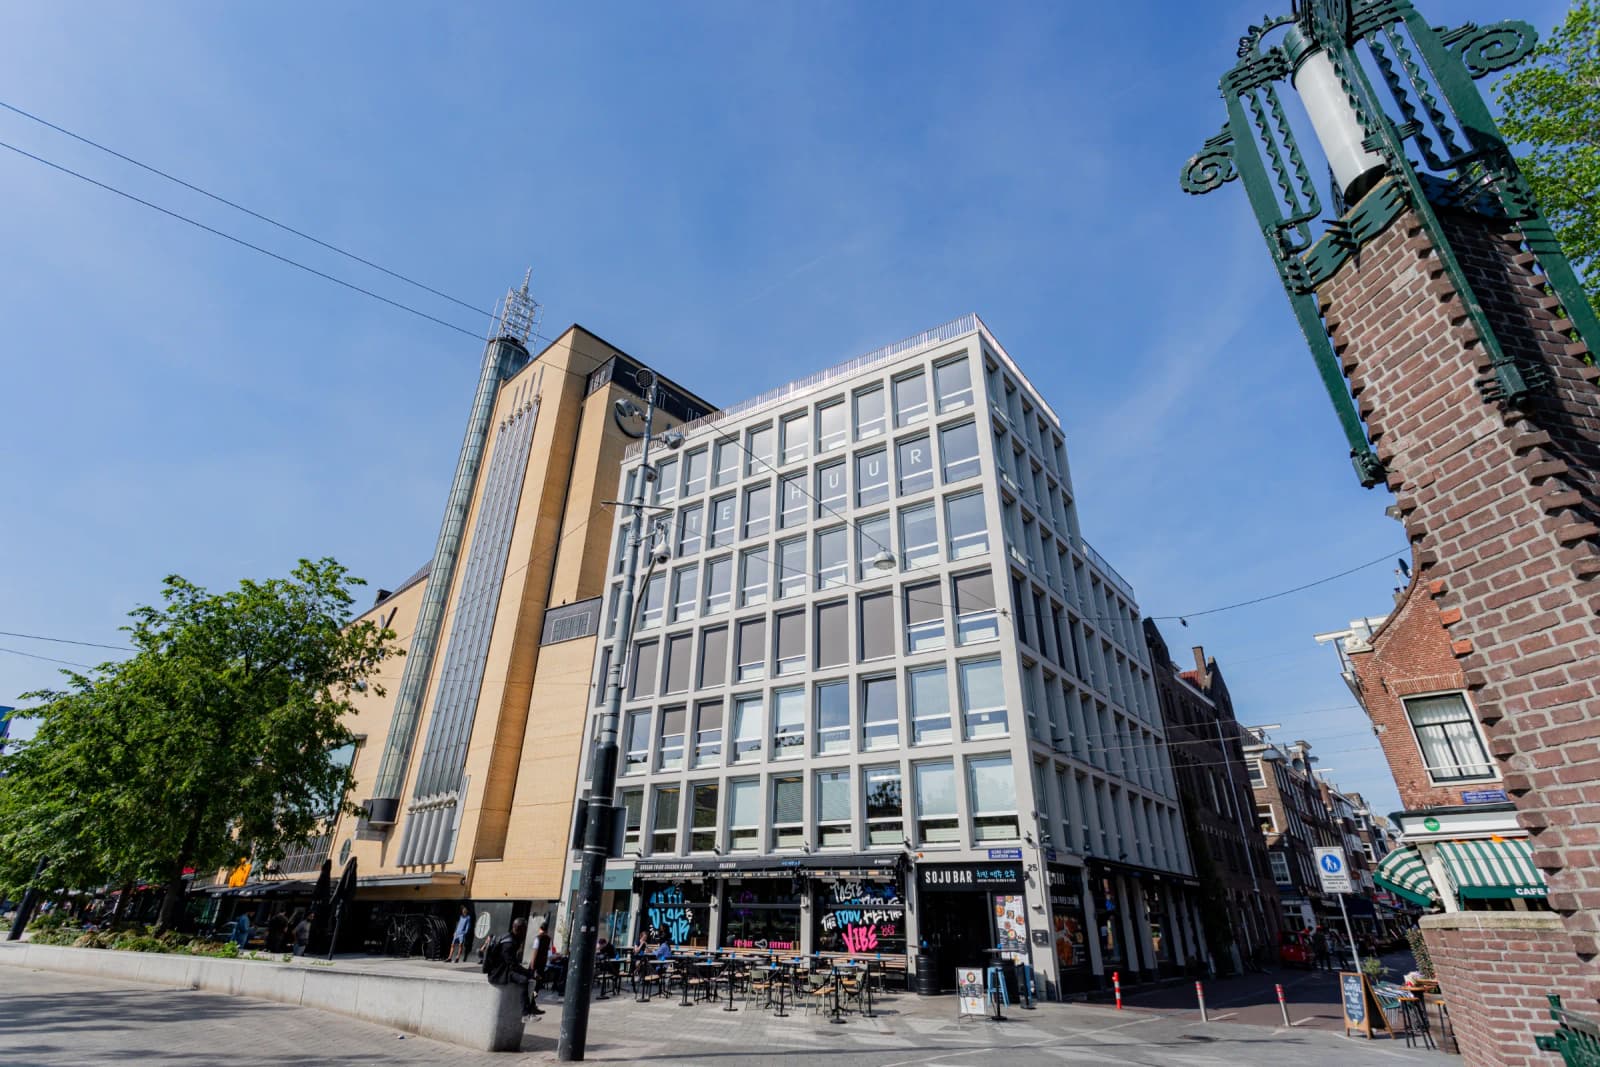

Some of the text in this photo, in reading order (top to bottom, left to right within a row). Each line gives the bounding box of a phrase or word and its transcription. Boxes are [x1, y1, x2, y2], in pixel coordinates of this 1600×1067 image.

[830, 881, 864, 903] TASTE
[821, 912, 837, 932] THE
[842, 923, 878, 954] VIBE
